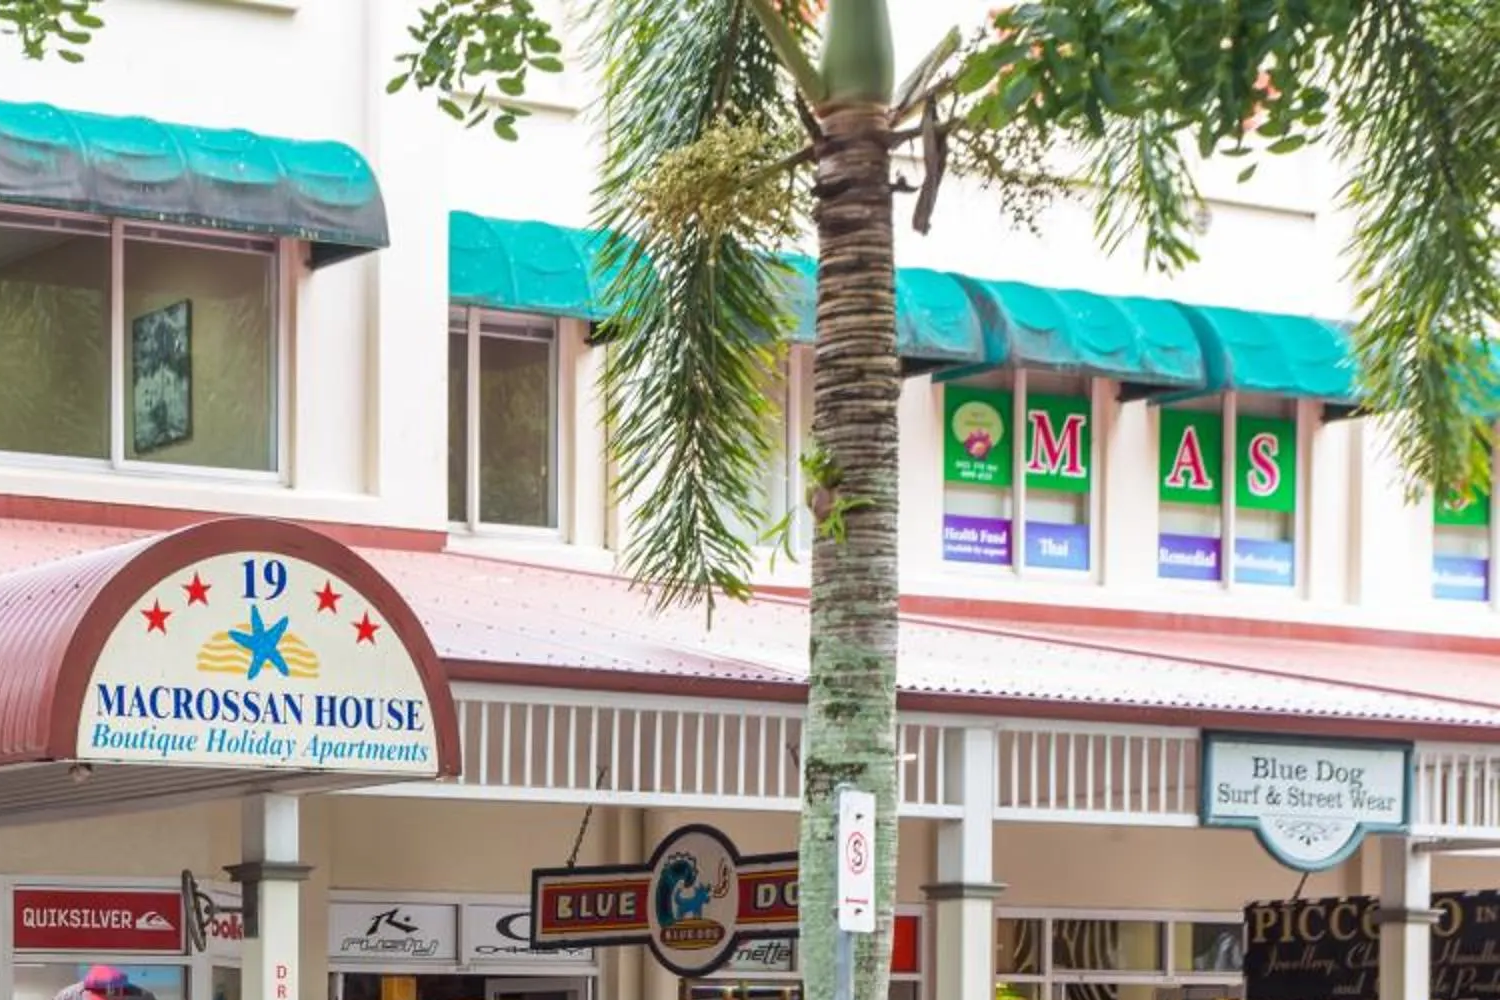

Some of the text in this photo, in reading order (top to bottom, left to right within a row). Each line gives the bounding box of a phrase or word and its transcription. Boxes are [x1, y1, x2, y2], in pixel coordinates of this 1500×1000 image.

[1028, 410, 1280, 497] M A S
[1039, 537, 1069, 557] Thai
[243, 559, 287, 600] 19
[97, 684, 424, 731] MACROSSAN HOUSE
[91, 723, 428, 764] Boutique Holiday Apartments
[1251, 756, 1365, 788] Blue Dog
[1217, 783, 1396, 811] Surf & Street Wear
[23, 908, 133, 929] QUIKSILVER
[557, 882, 799, 920] BLUE DO
[737, 942, 790, 965] nette
